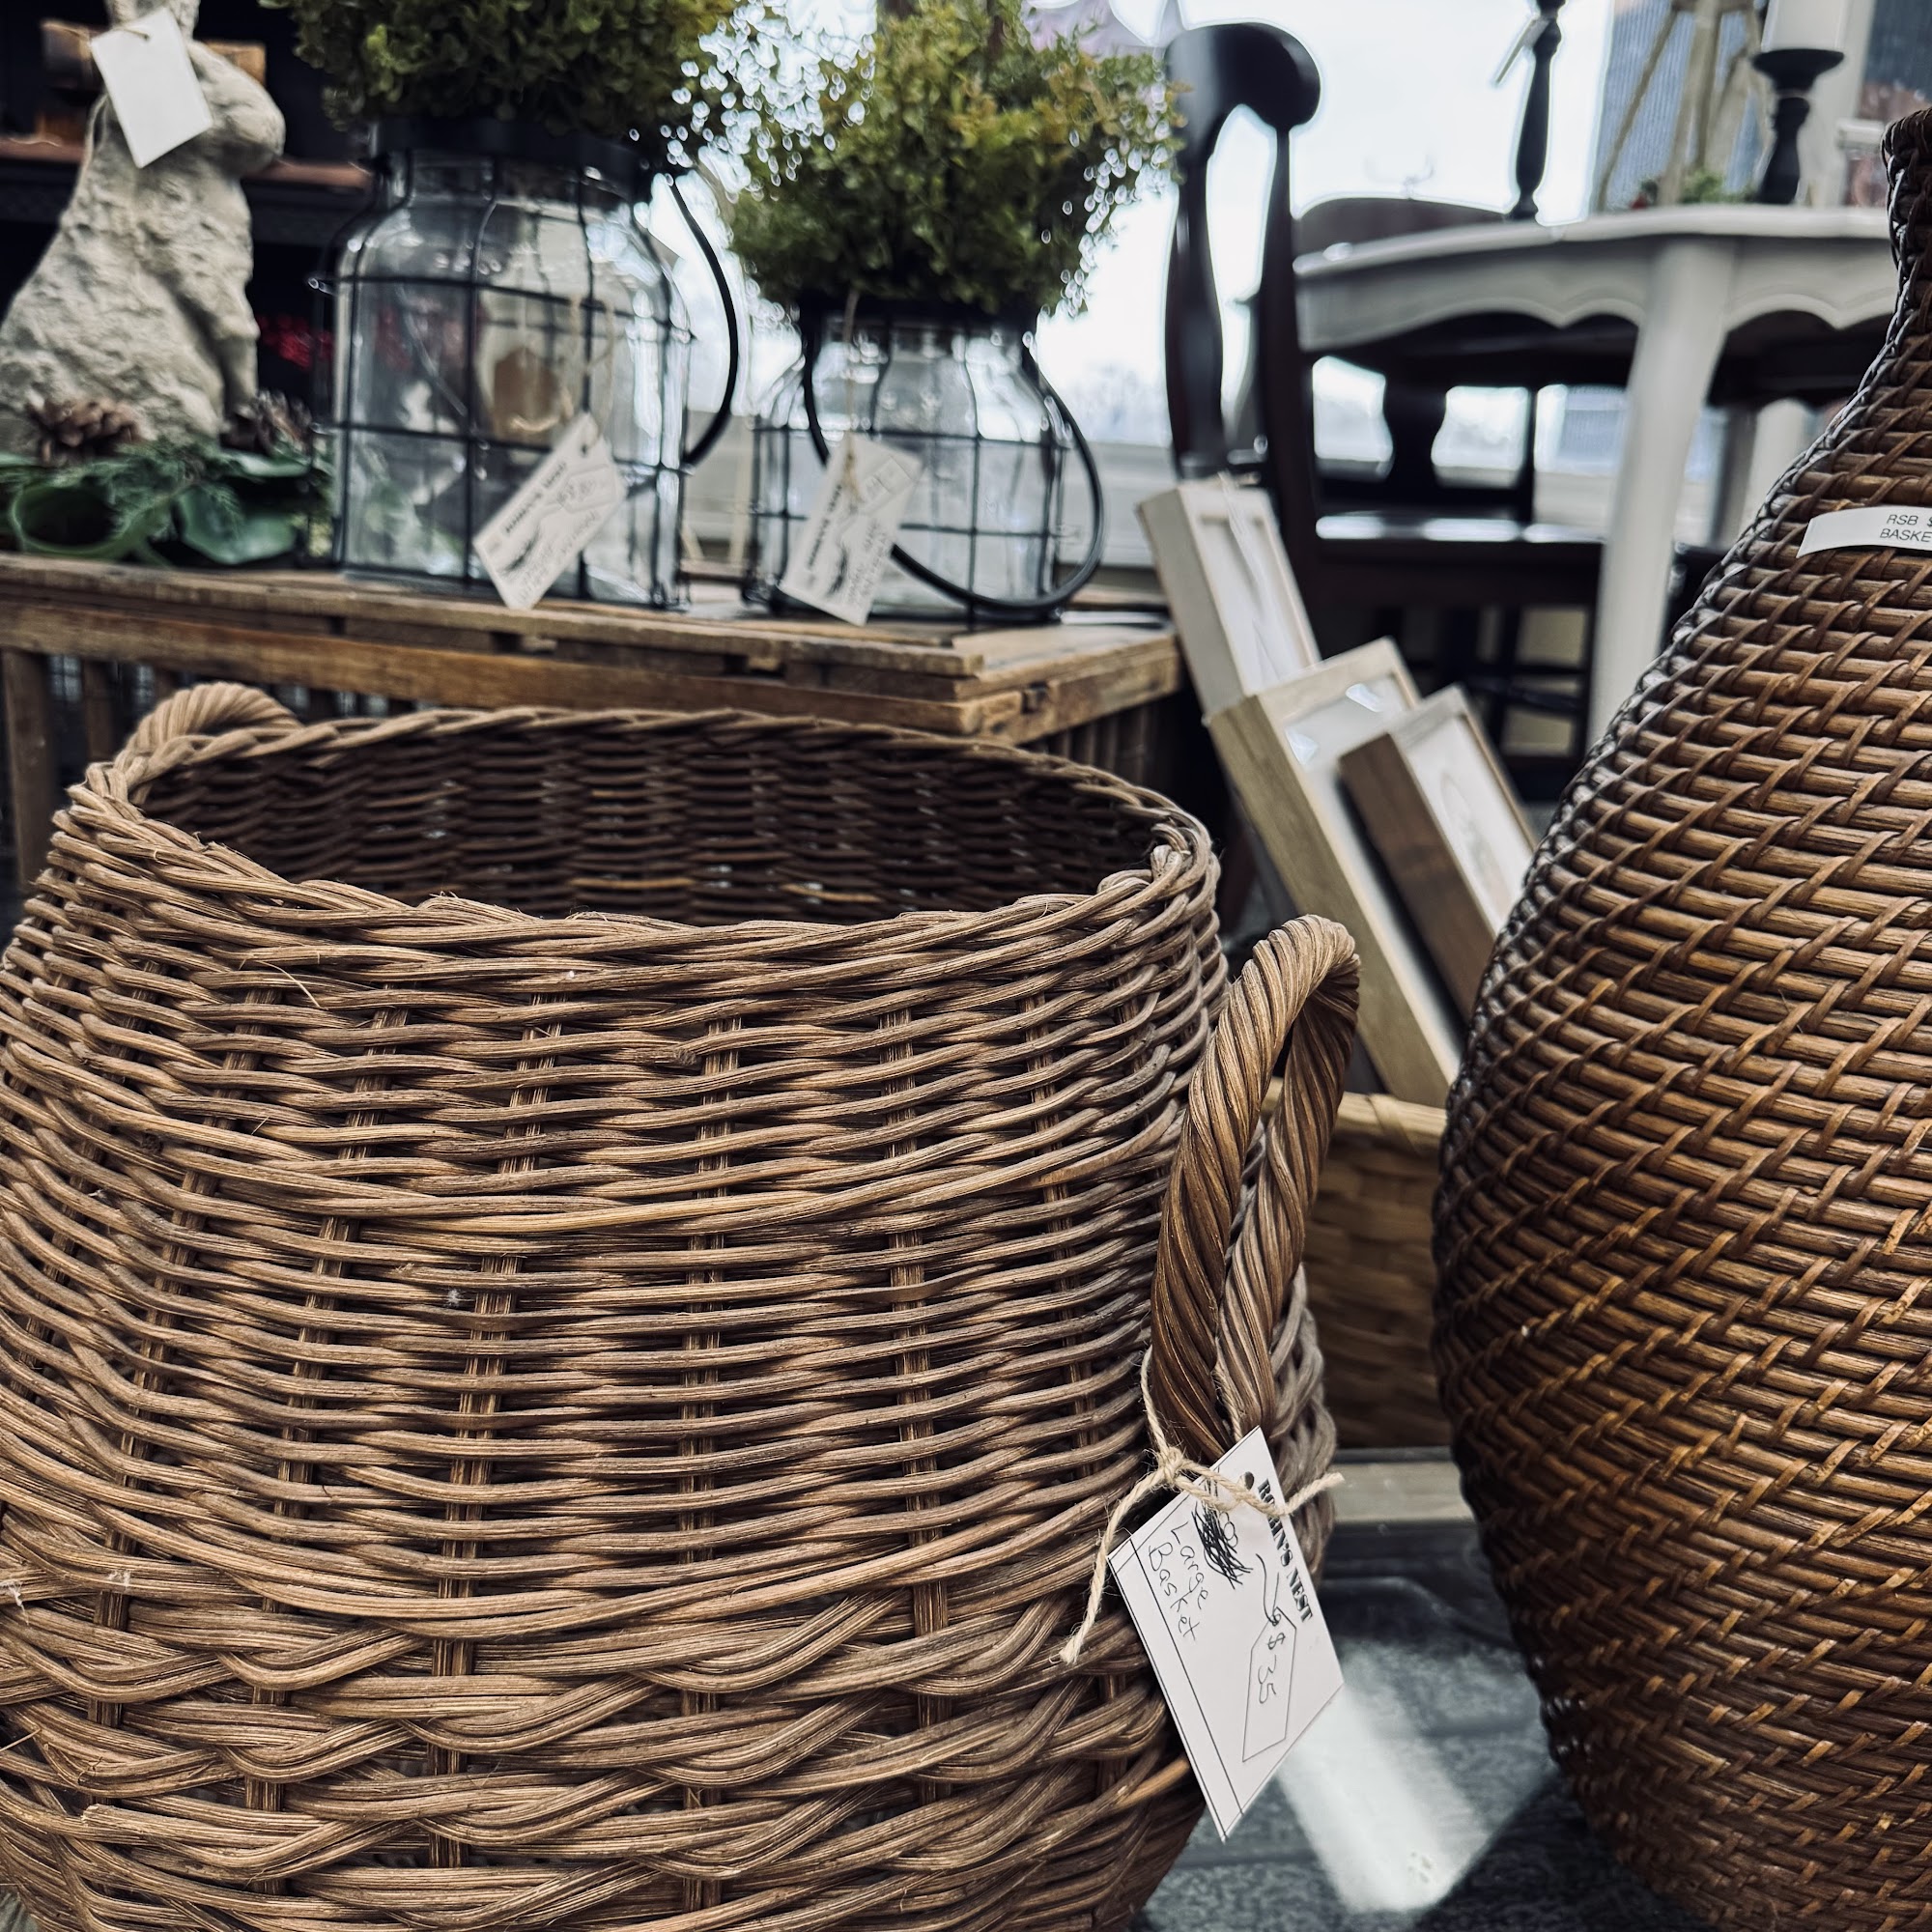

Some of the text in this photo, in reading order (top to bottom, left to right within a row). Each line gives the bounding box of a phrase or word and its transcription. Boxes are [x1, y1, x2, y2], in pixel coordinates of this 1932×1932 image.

[1887, 514, 1918, 526] RSB
[1149, 1542, 1200, 1641] Basket
[1171, 1520, 1208, 1610] Large
[1286, 1567, 1313, 1623] NEST
